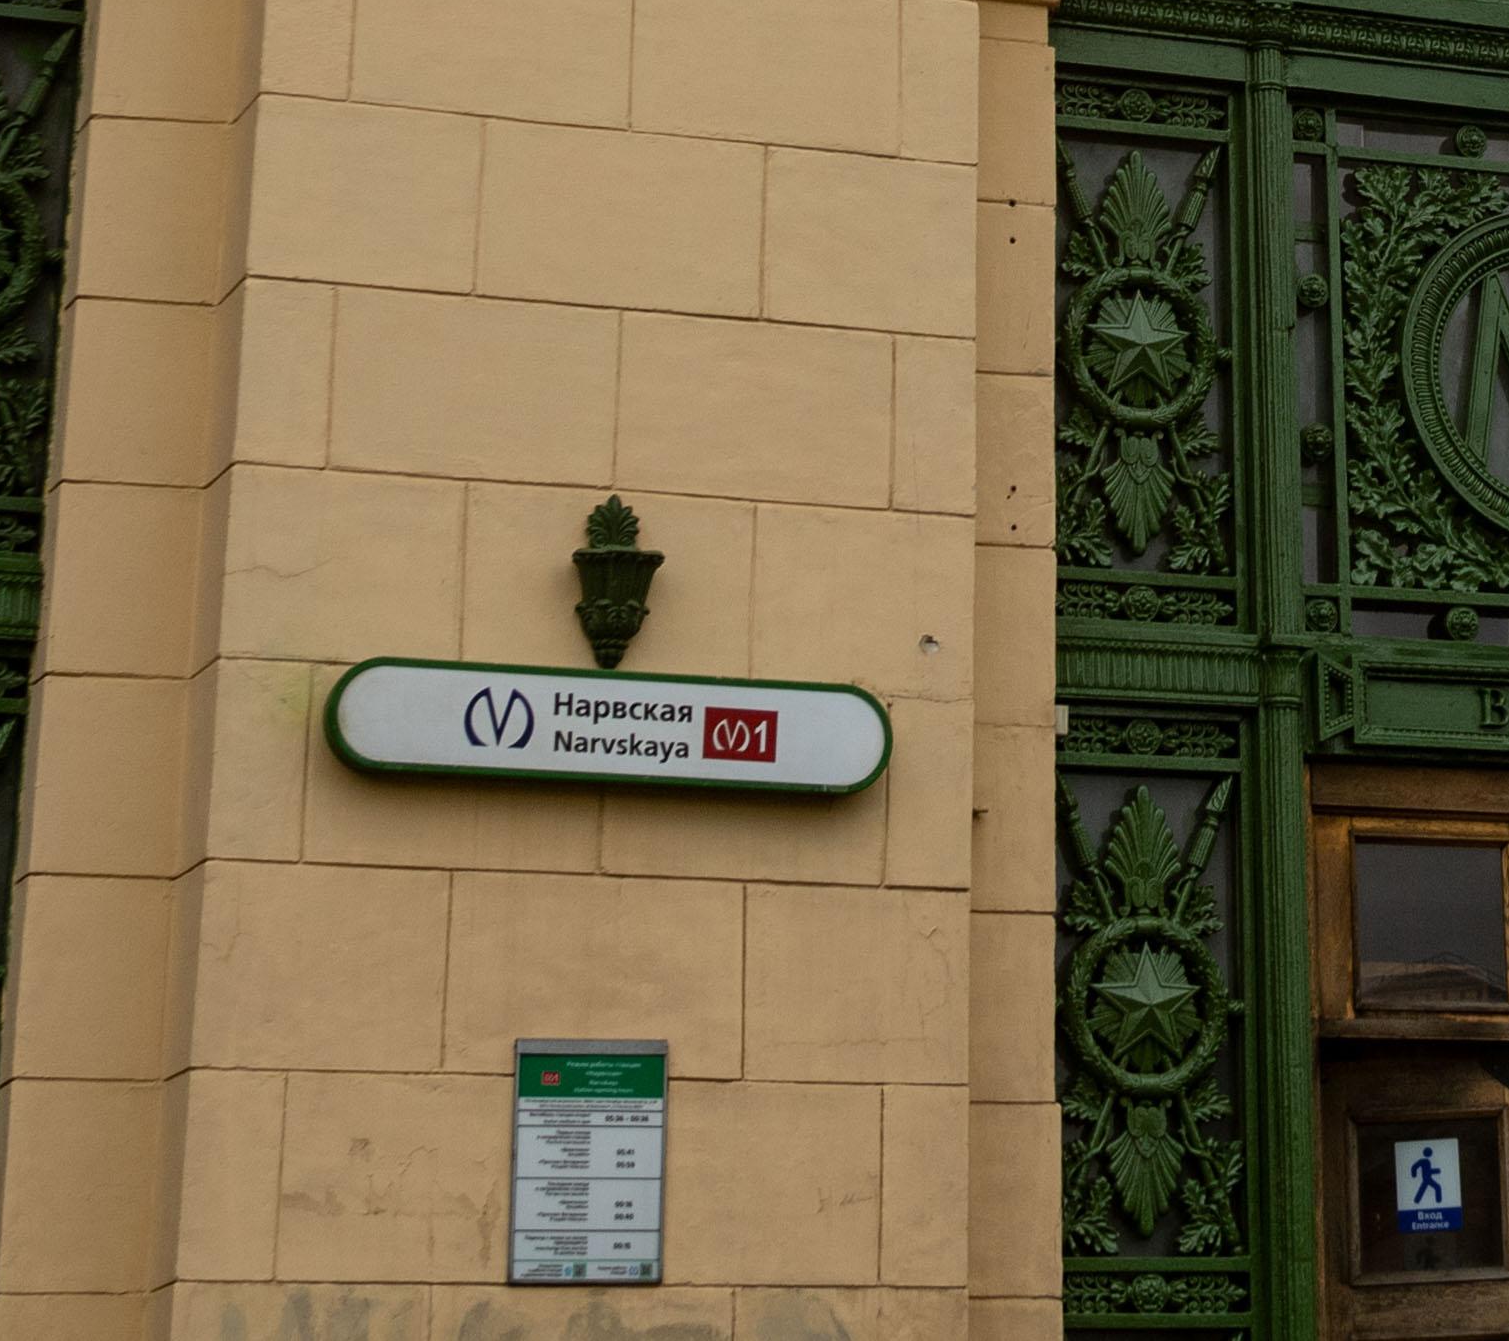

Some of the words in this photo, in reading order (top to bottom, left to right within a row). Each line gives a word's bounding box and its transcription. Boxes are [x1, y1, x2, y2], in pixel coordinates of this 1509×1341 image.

[553, 692, 693, 725] Нарвская
[553, 730, 690, 764] Narvskaya
[1411, 1220, 1450, 1230] Entrance
[1417, 1211, 1443, 1220] Вход
